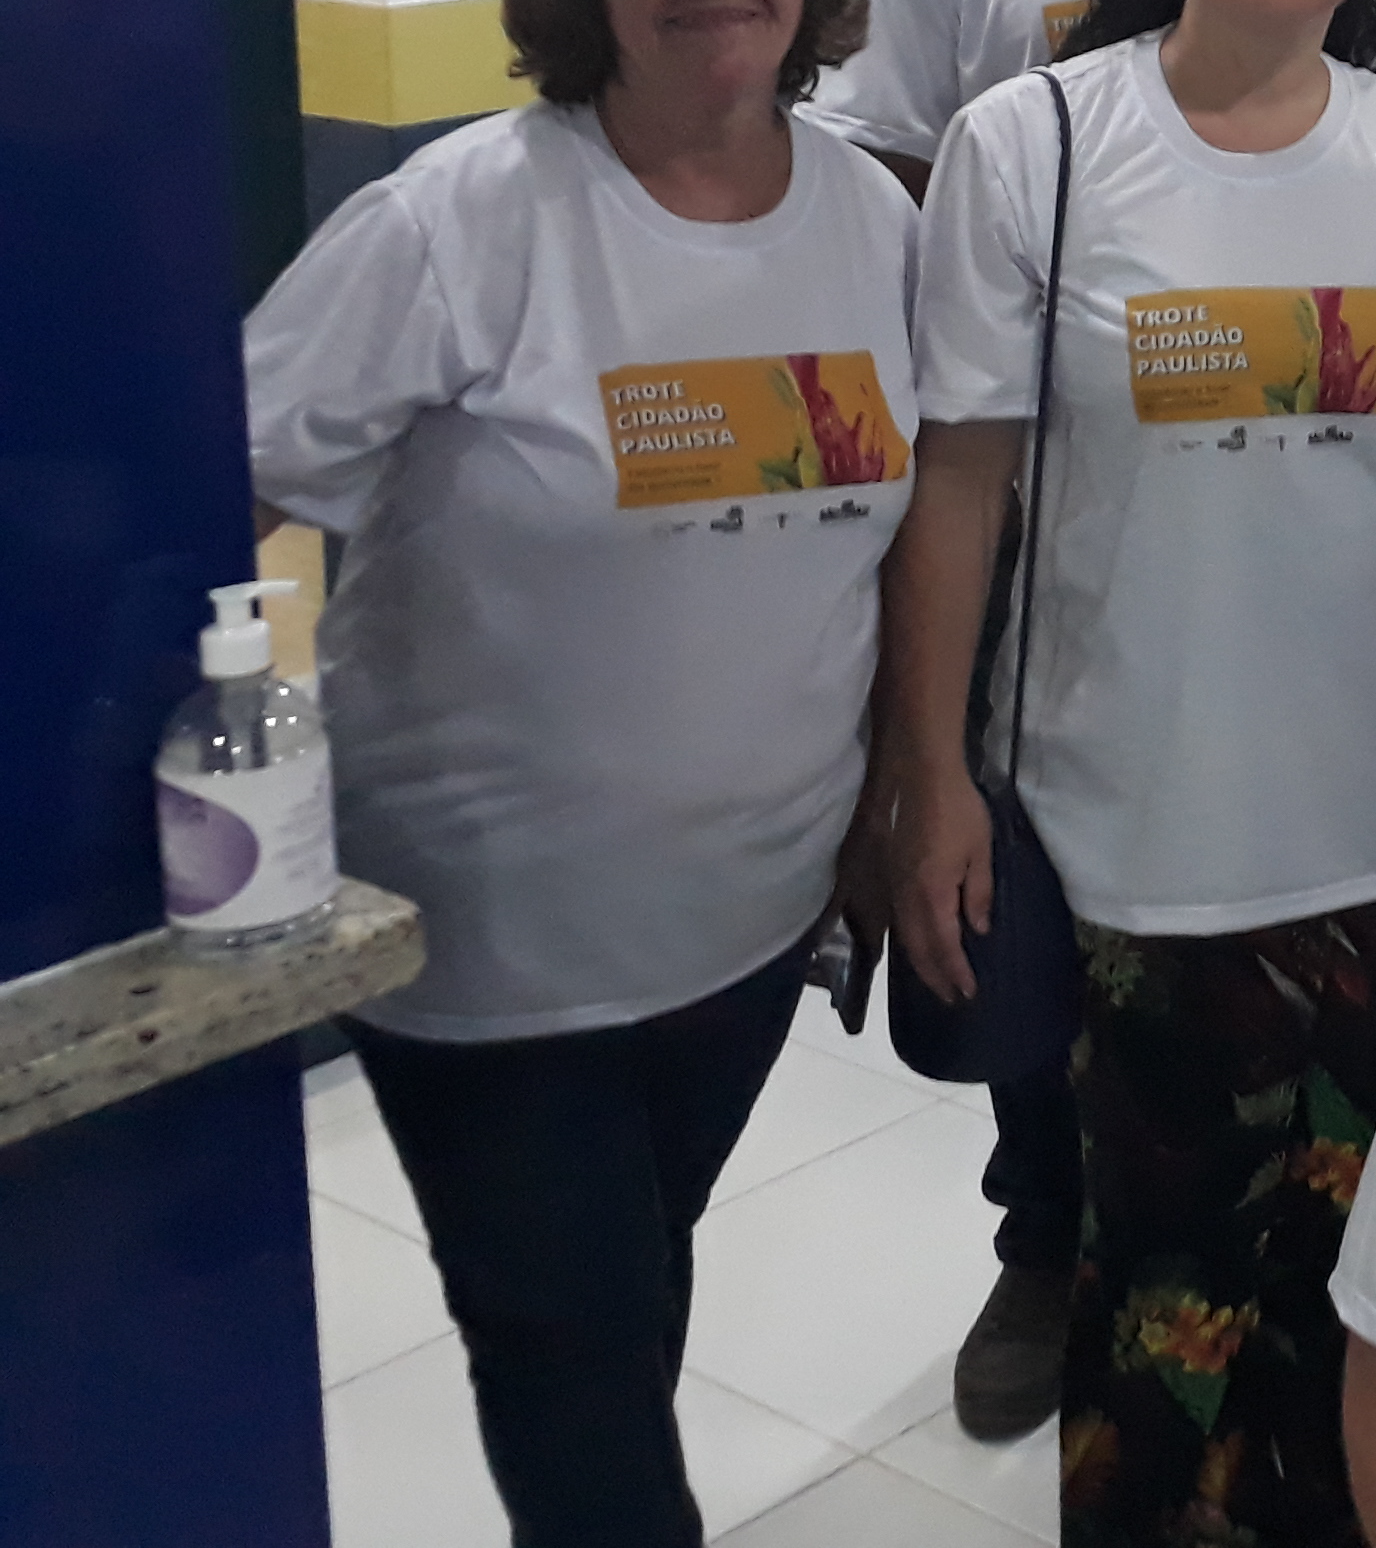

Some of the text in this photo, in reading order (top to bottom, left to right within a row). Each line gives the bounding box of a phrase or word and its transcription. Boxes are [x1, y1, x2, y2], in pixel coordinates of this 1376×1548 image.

[1134, 304, 1209, 328] TROTE
[1135, 324, 1245, 351] CIDADÃO
[1137, 351, 1249, 376] PAULISTA
[611, 379, 686, 405] TROTE
[617, 400, 726, 429] CIDADÃO
[620, 428, 737, 454] PAULISTA
